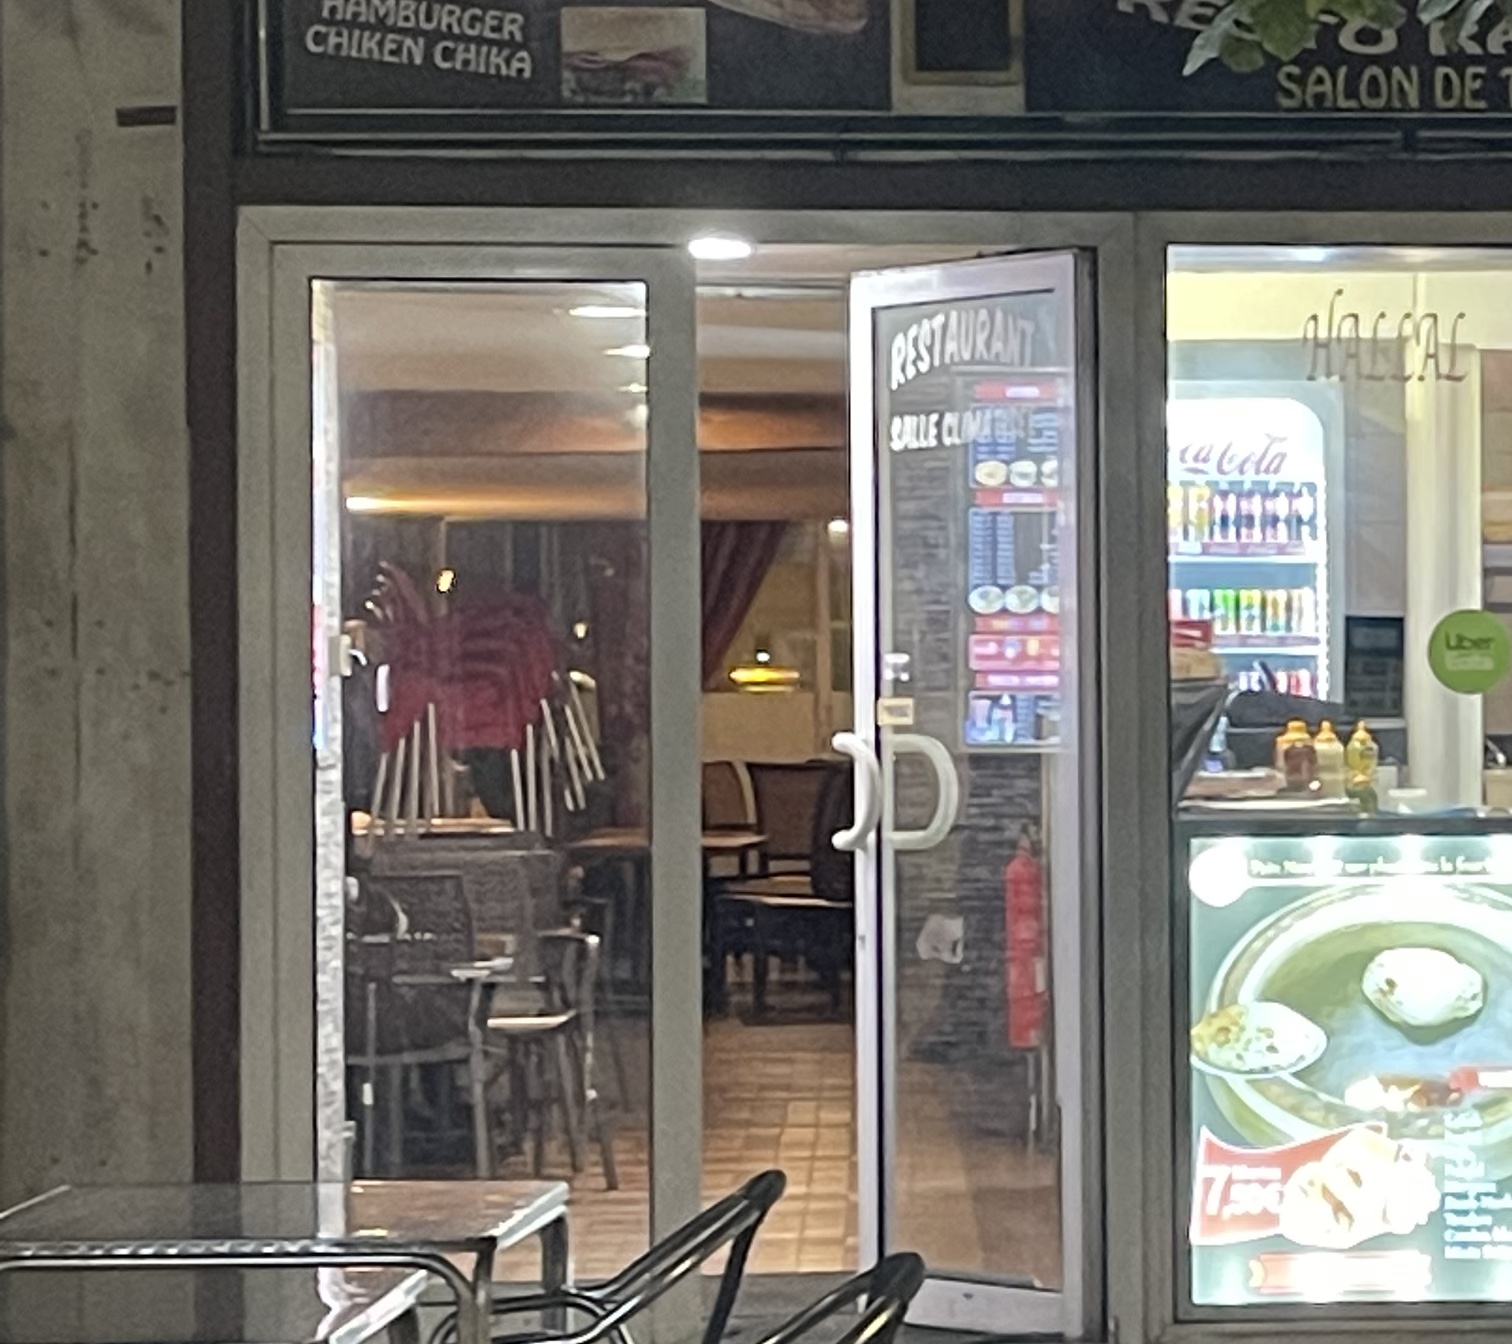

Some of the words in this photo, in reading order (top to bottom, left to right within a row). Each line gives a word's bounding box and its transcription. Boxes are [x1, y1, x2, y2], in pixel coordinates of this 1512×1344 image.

[305, 24, 424, 67] CHIKEN
[433, 39, 532, 79] CHIKA
[1277, 65, 1420, 111] SALON
[1434, 65, 1488, 109] DE
[890, 306, 1035, 391] RESTAURANT
[890, 412, 939, 452] SALLE
